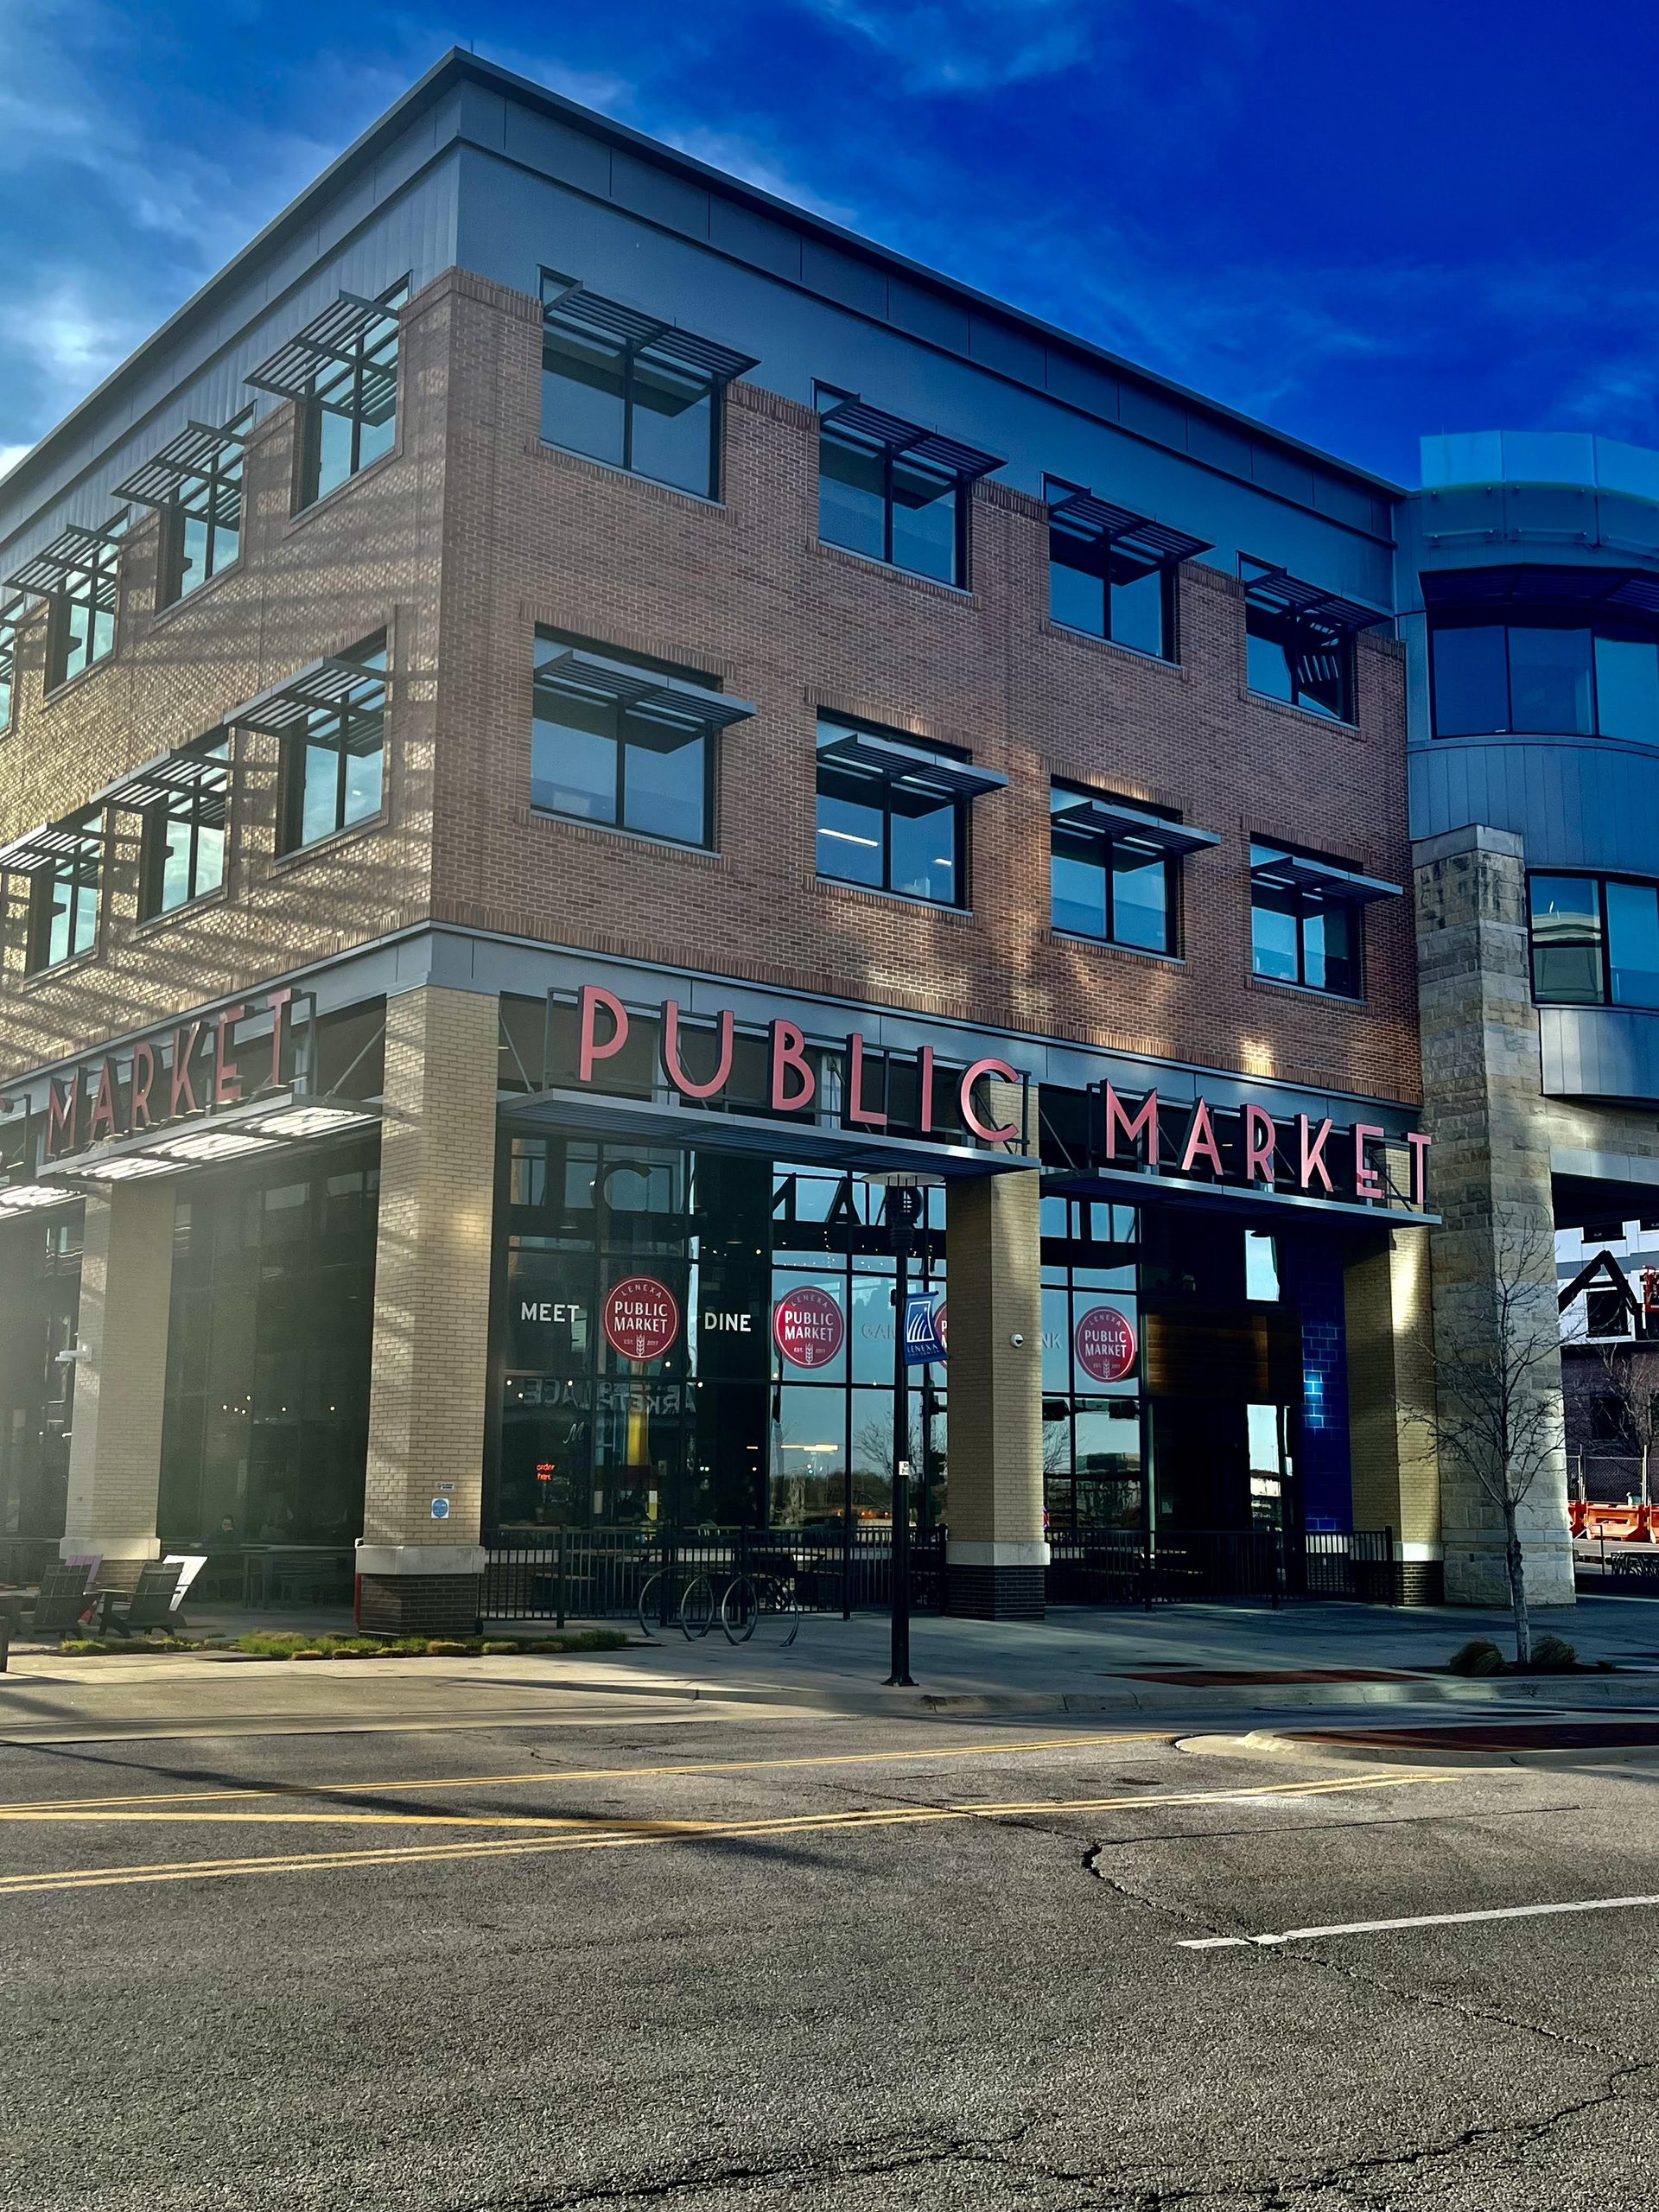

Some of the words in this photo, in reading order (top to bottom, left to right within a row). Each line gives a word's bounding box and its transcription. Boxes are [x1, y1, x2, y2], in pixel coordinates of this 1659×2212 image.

[46, 988, 294, 1156] MARKET
[578, 985, 1020, 1142] PUBLIC
[1103, 1079, 1432, 1205] MARKET
[621, 1284, 663, 1299] LENEXA
[614, 1300, 668, 1317] PUBLIC
[790, 1294, 829, 1309] LENEXA
[521, 1301, 580, 1323] MEET
[785, 1310, 834, 1325] PUBLIC
[1090, 1314, 1122, 1327] LENEXA
[614, 1316, 668, 1334] MARKET
[704, 1312, 752, 1332] DINE
[785, 1325, 834, 1342] MARKET
[1084, 1330, 1128, 1344] PUBLIC
[1084, 1343, 1128, 1358] MARKET
